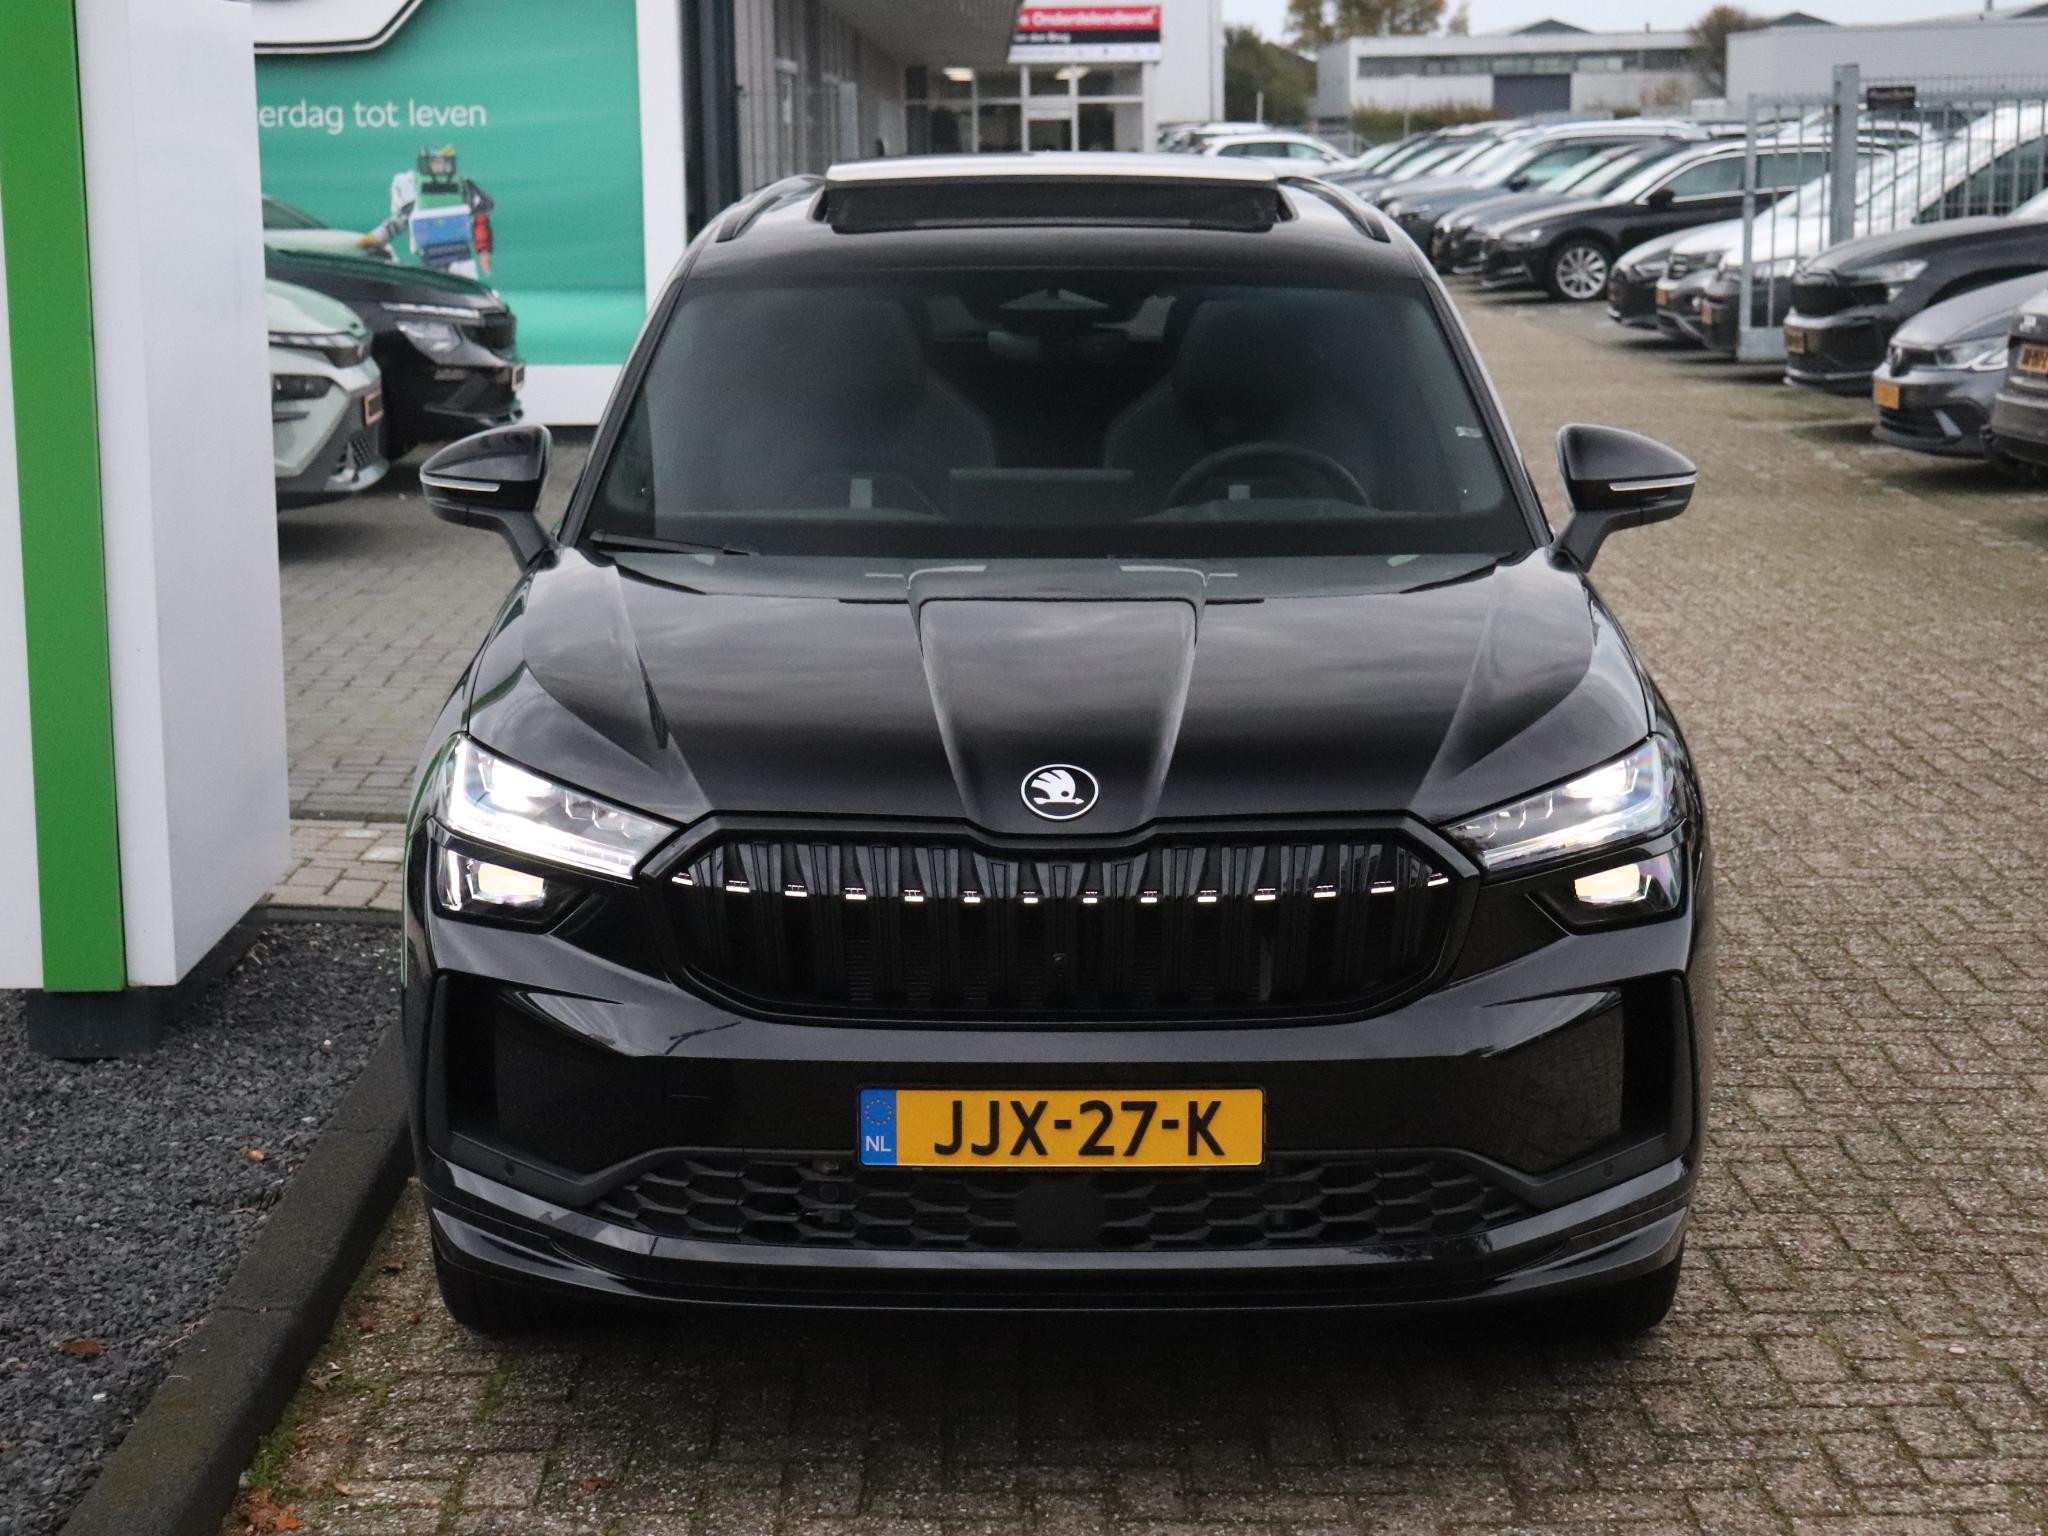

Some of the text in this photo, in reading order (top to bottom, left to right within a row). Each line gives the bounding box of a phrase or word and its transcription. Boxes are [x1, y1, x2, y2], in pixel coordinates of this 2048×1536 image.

[258, 98, 488, 136] erdag tot leven
[865, 1135, 892, 1152] NL
[934, 1100, 1225, 1156] JJX-27-K
